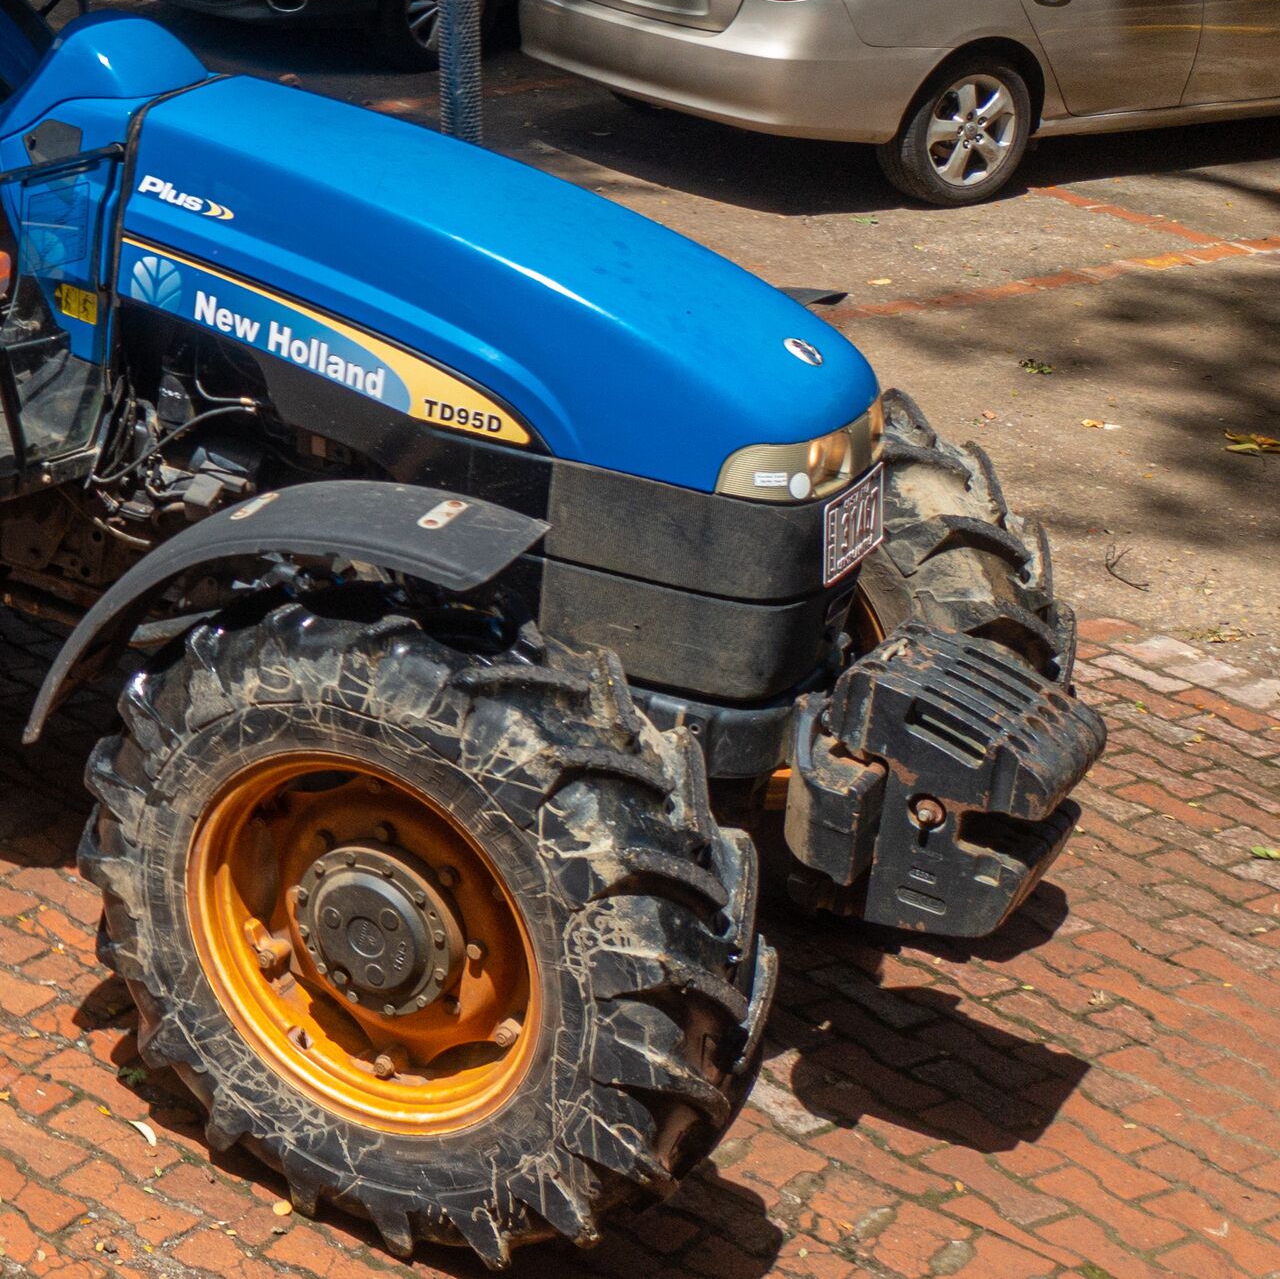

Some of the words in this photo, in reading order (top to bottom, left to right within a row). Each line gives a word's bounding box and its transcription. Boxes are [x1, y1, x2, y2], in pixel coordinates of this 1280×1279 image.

[138, 174, 204, 211] Plus
[194, 290, 260, 344] New
[267, 321, 385, 400] Holland
[424, 398, 502, 433] TD95D
